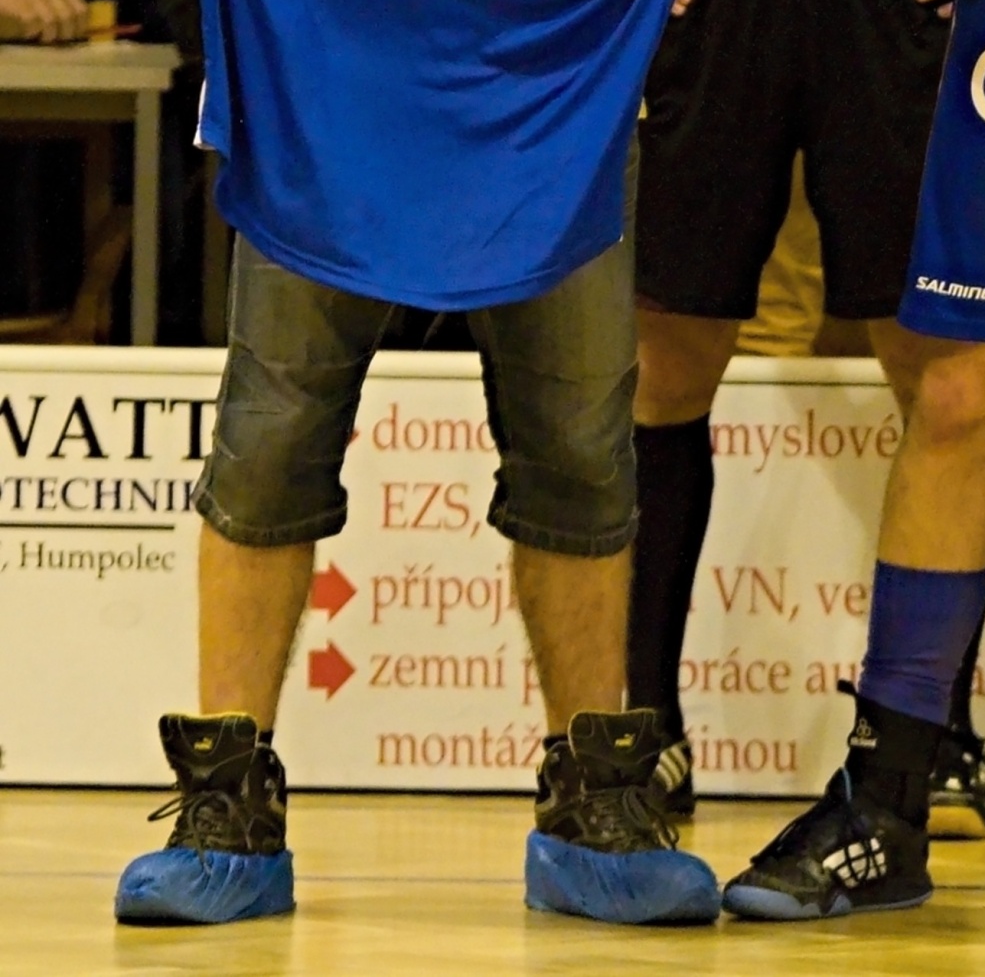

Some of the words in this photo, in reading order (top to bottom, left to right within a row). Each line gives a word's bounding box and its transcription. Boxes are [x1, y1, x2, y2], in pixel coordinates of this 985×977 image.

[711, 408, 899, 474] myslové
[0, 477, 195, 512] TECHNI
[380, 482, 481, 539] EZS,
[19, 540, 176, 580] Humpolec
[371, 563, 518, 626] přípoj
[713, 566, 799, 622] VN,
[369, 642, 508, 689] zemní
[377, 722, 542, 768] montáž
